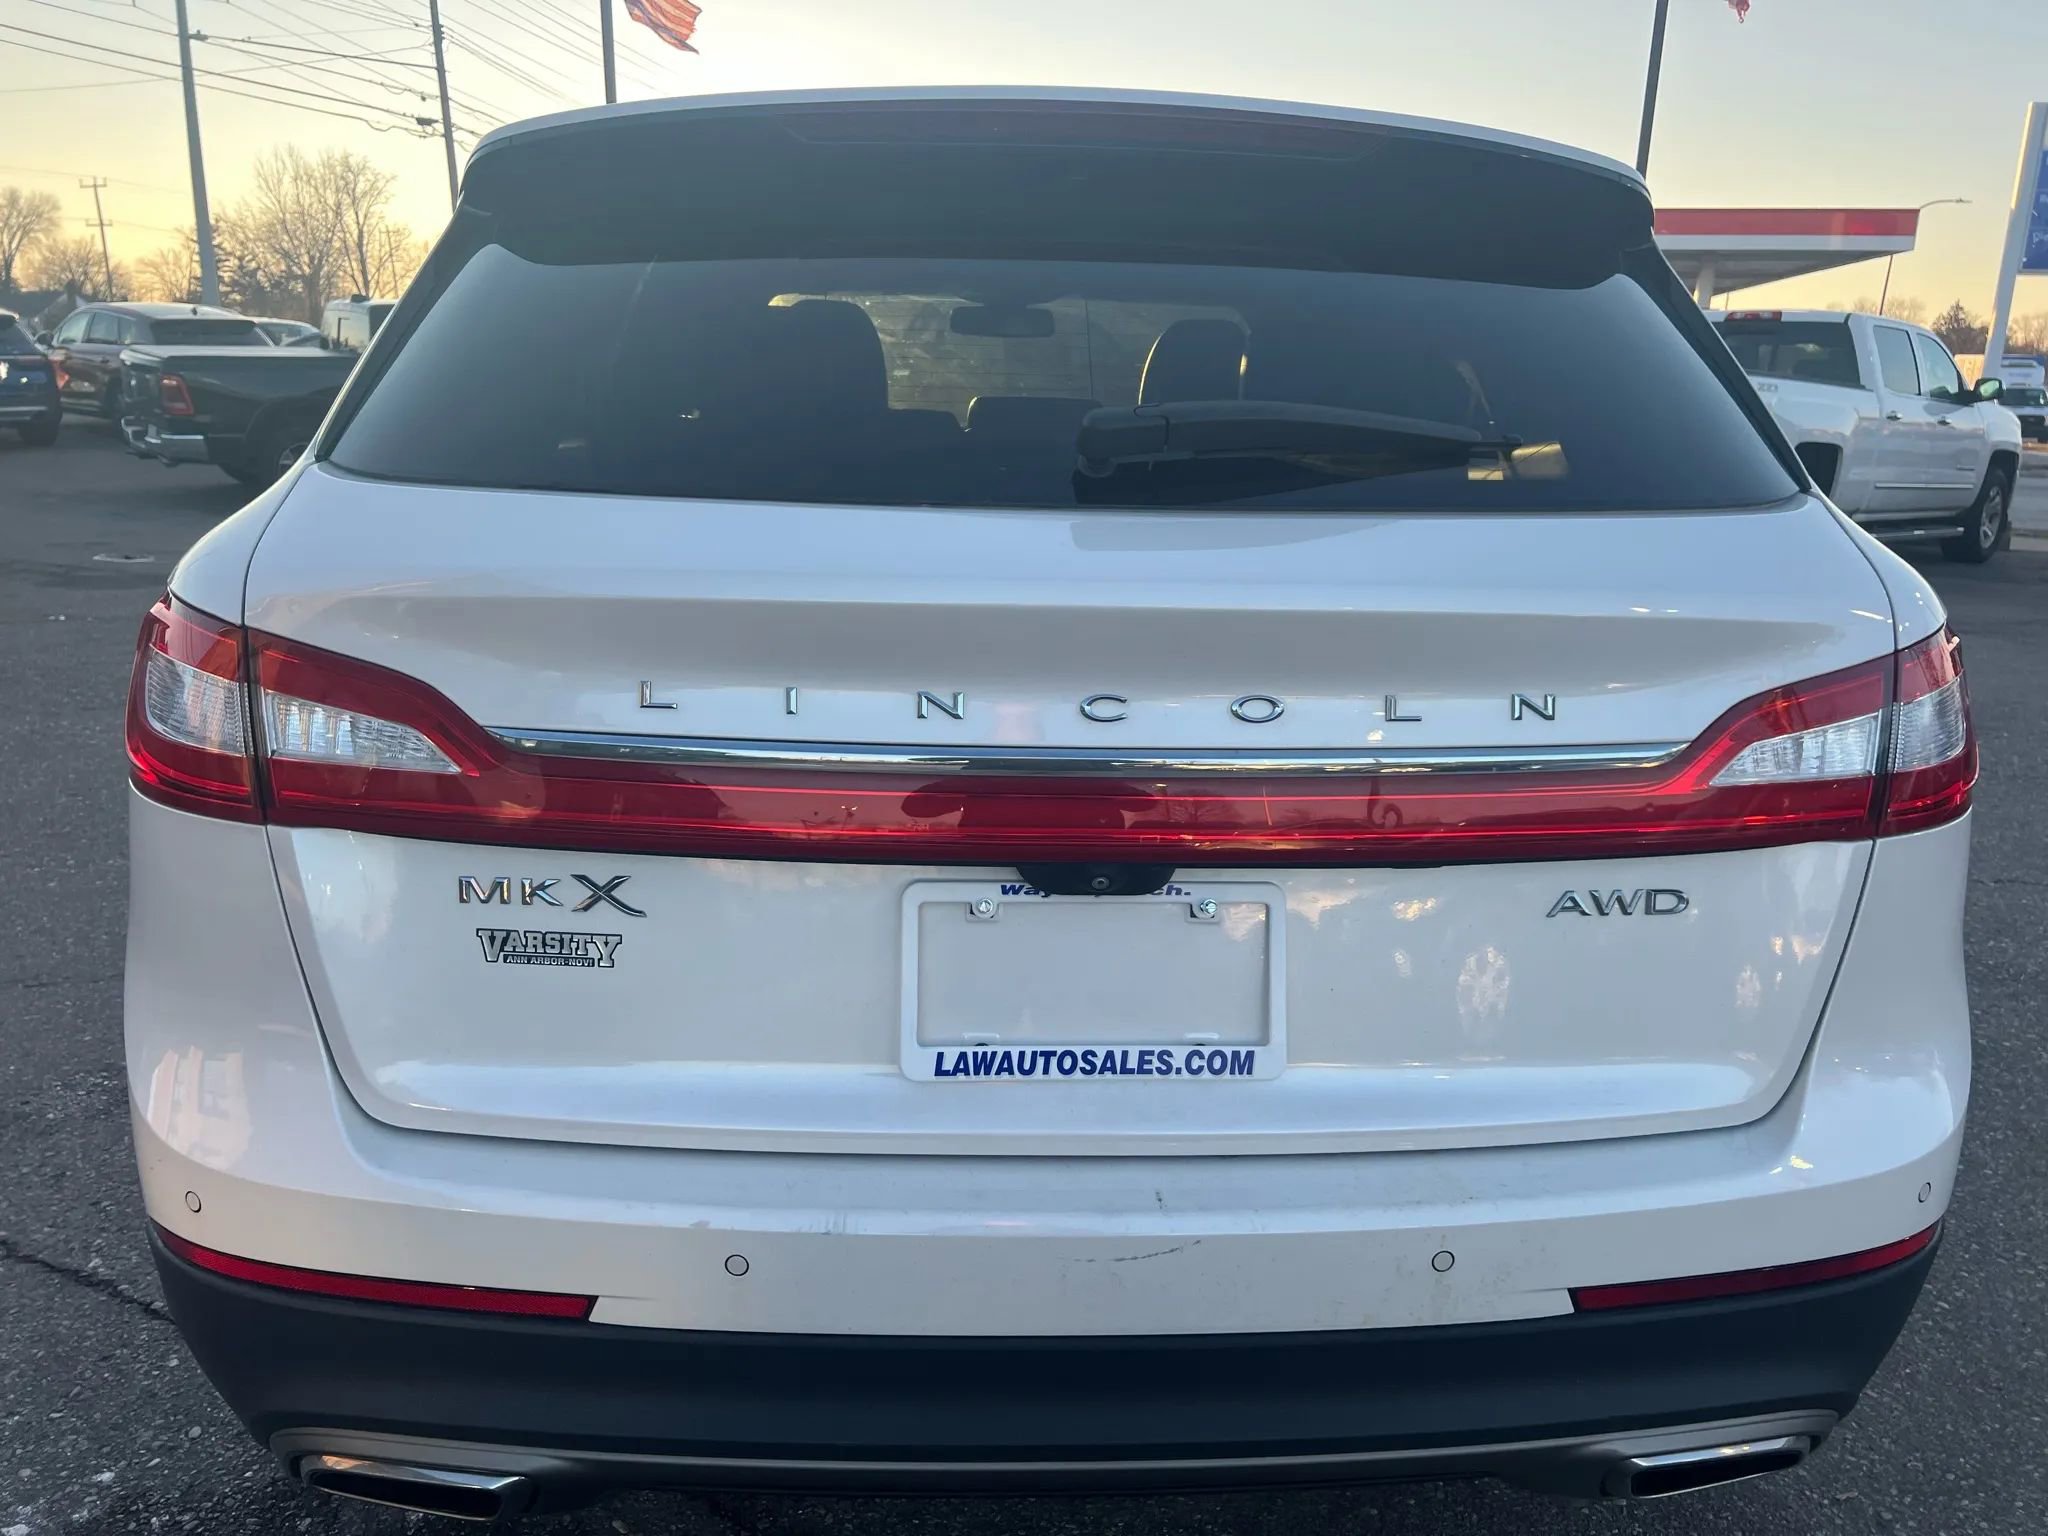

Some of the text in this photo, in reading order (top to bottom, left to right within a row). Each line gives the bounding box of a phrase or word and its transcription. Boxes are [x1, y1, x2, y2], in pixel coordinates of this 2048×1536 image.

[638, 679, 1557, 722] LINCOLN
[458, 873, 648, 918] MKX
[1545, 888, 1690, 918] AWD
[476, 927, 623, 968] VARSITY
[506, 955, 528, 964] ANN
[933, 1049, 1256, 1077] LAWAUTOSALES.COM
